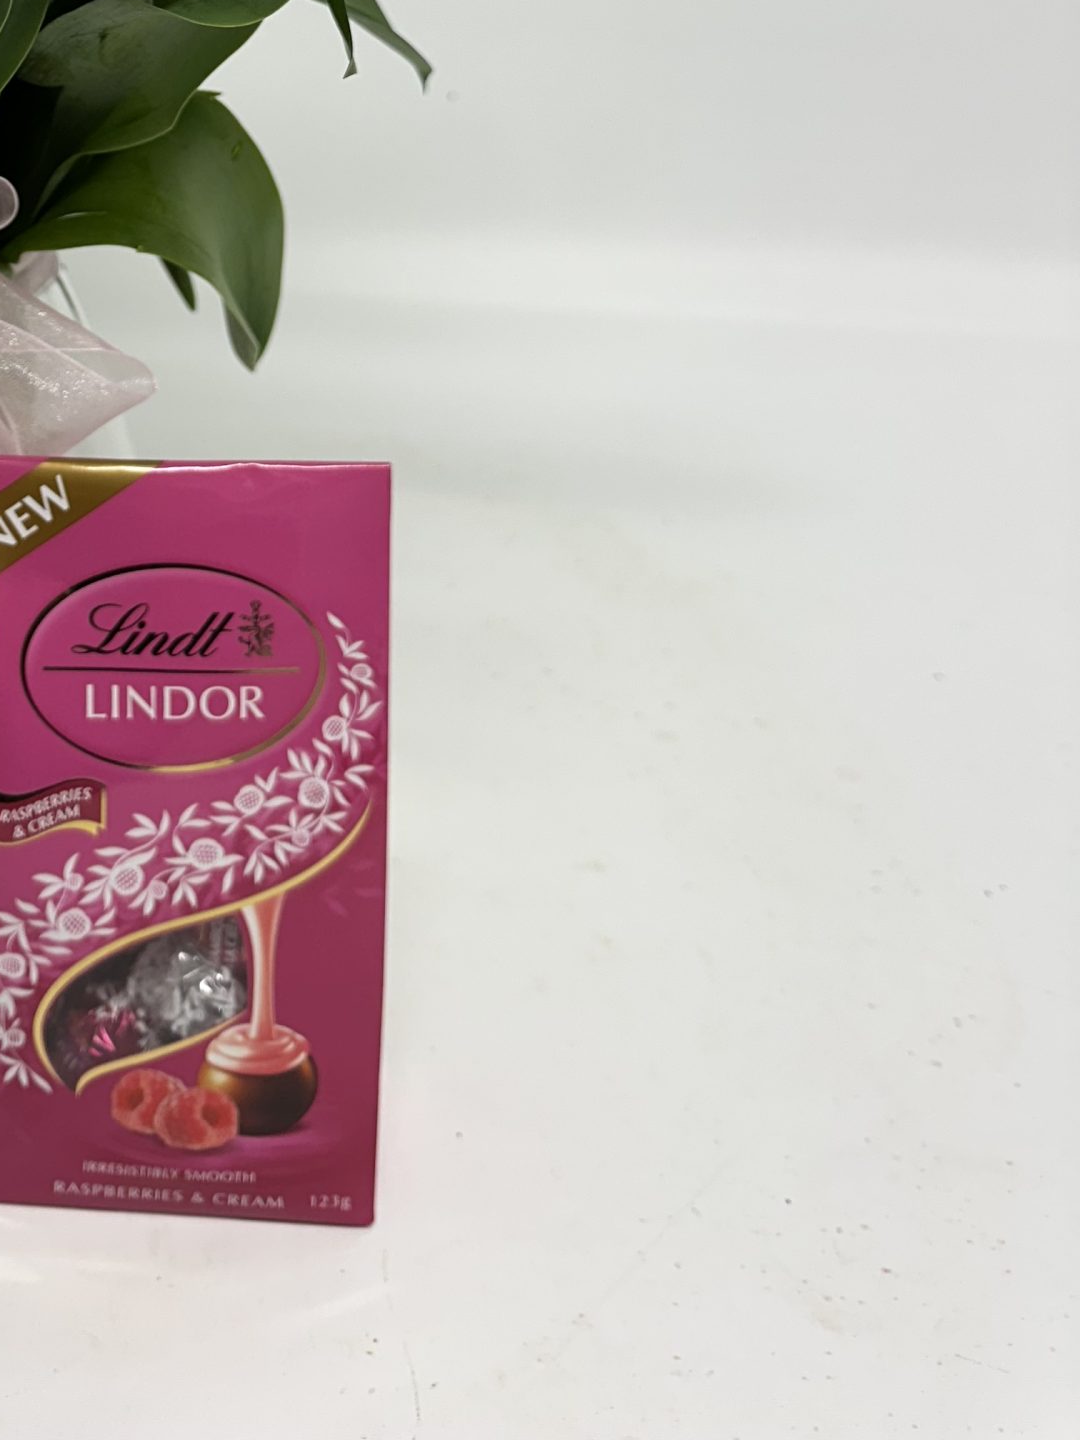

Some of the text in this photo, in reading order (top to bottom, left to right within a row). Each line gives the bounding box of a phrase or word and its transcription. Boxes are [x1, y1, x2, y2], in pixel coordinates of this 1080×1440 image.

[70, 602, 237, 658] Lindt
[84, 684, 266, 720] LINDOR
[27, 803, 81, 834] CREAM
[183, 1167, 257, 1184] SMOOTH
[53, 1178, 285, 1209] RASPBERRIES & CREAM
